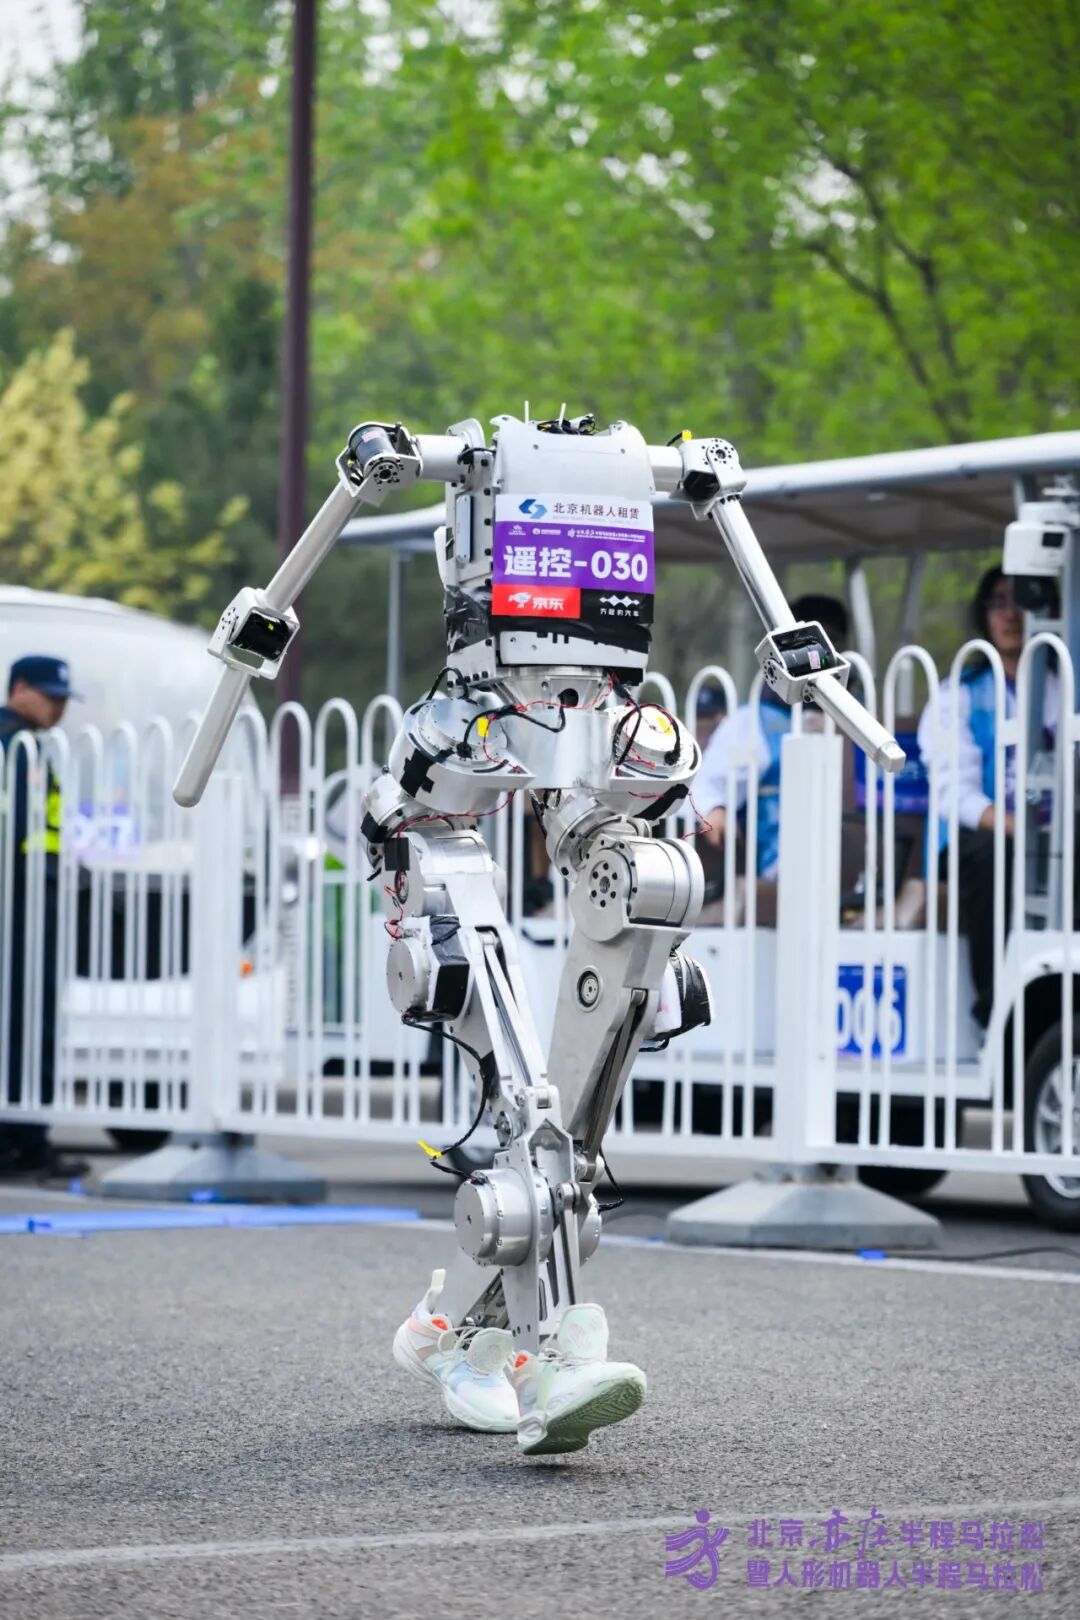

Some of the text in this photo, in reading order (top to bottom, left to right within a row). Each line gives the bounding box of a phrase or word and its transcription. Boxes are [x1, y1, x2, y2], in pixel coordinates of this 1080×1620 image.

[553, 502, 639, 520] 北京机器人租赁
[503, 545, 648, 582] 遥控-030
[532, 597, 565, 611] 京东
